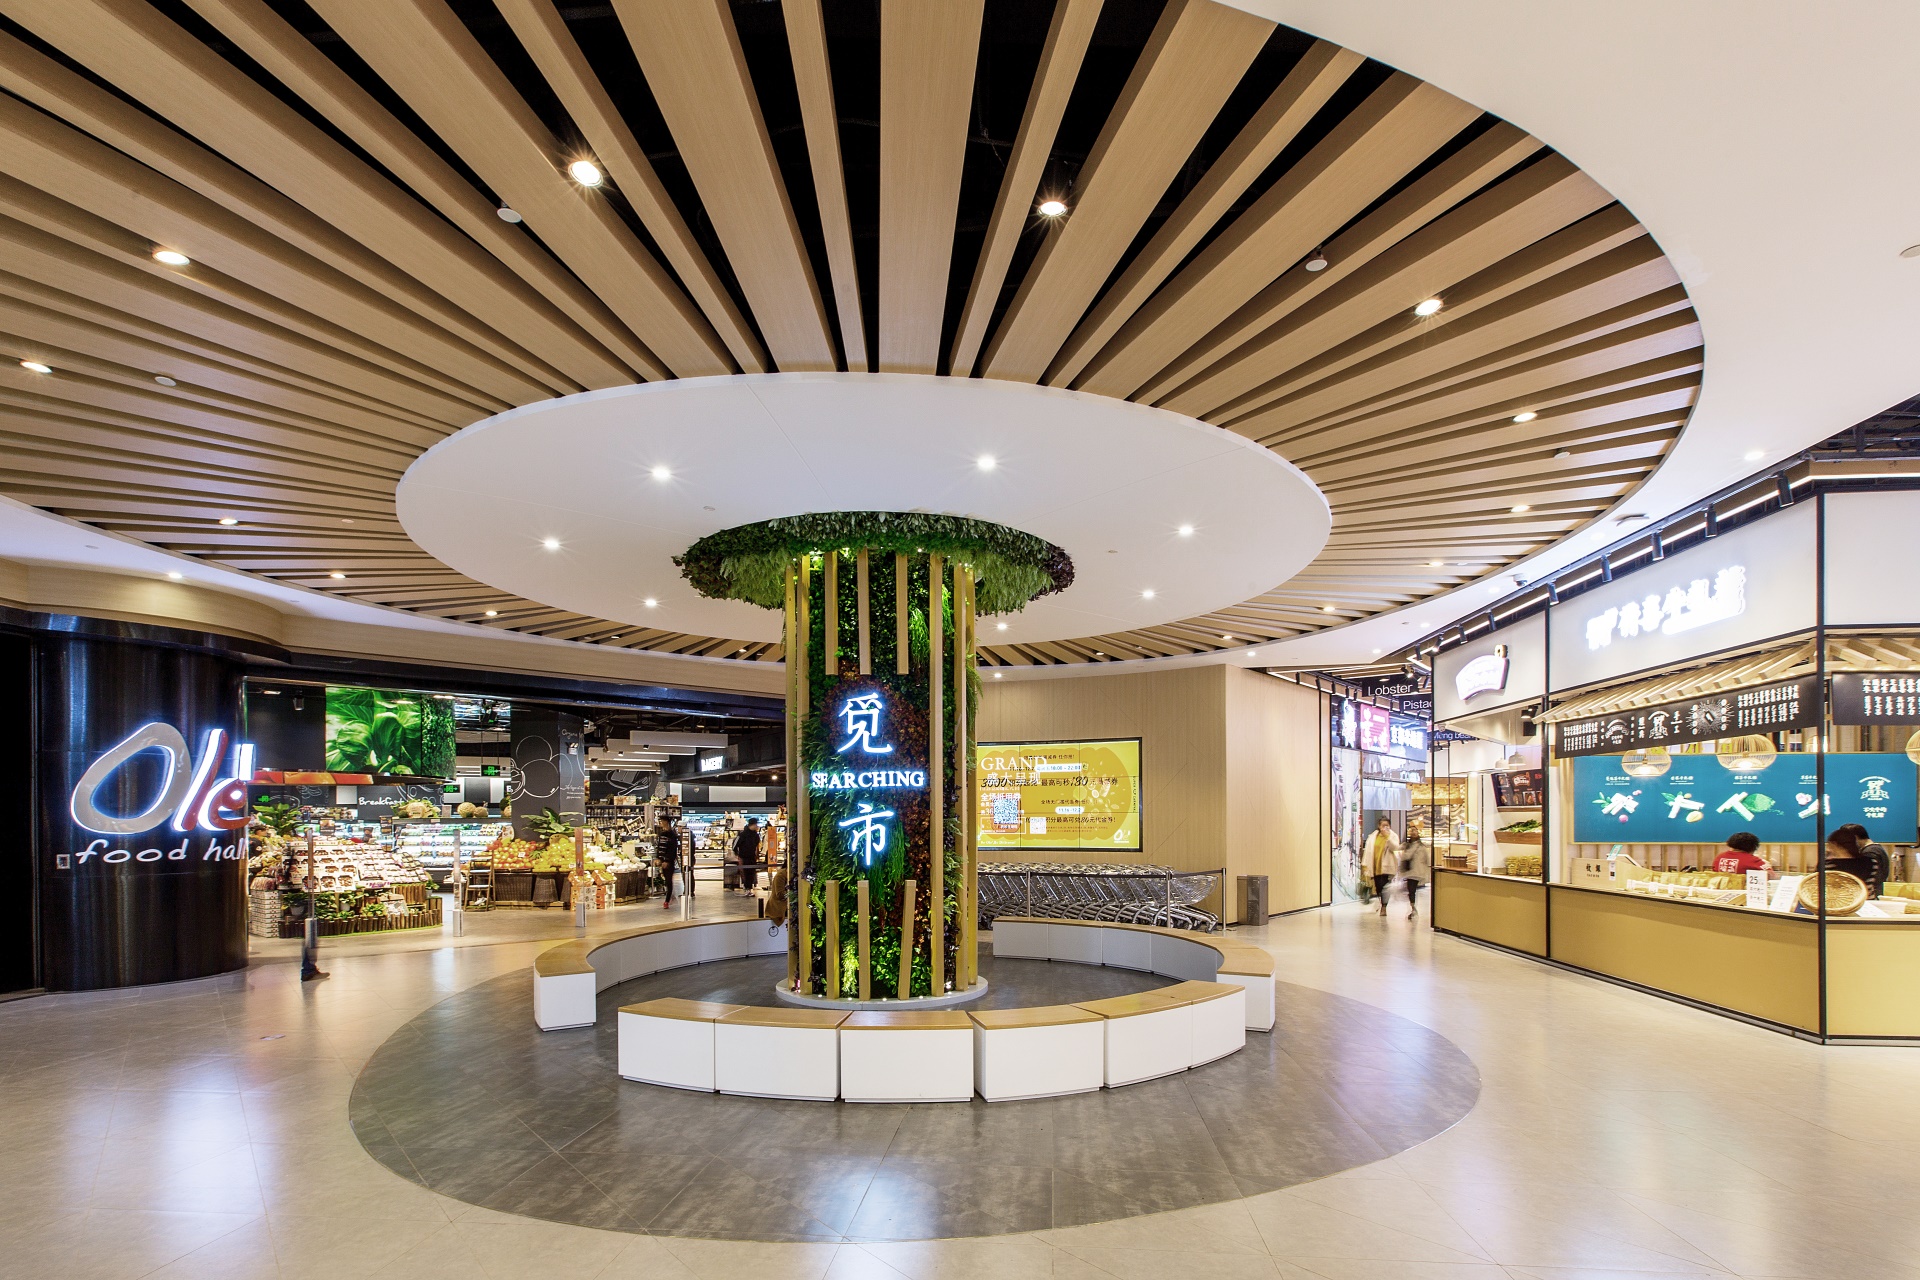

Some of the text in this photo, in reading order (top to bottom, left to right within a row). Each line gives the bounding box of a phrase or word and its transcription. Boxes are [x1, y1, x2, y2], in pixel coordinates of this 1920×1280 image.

[1368, 683, 1413, 696] Lobster
[837, 692, 893, 753] 觅
[980, 756, 1047, 771] GRAND
[811, 771, 925, 789] SEARCHING
[358, 796, 405, 806] Breakfast
[838, 803, 895, 867] 市
[75, 837, 248, 864] food hall
[1749, 875, 1759, 885] 25
